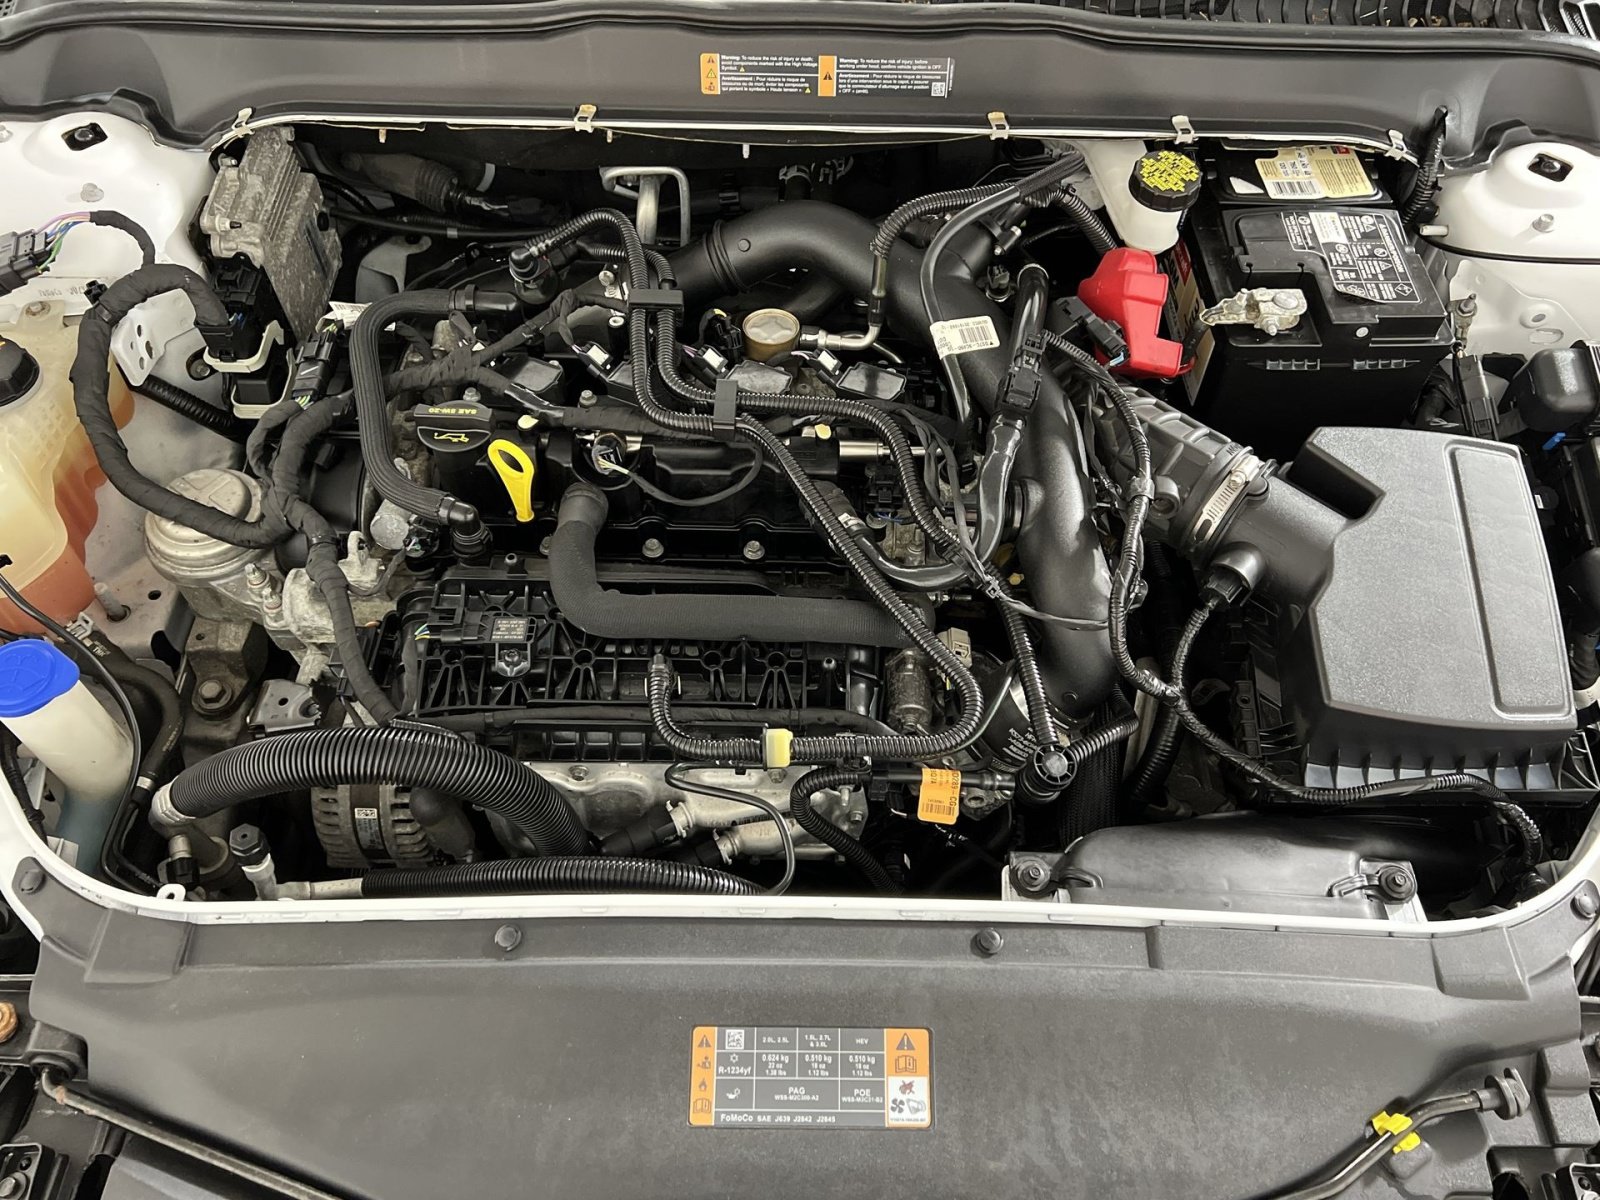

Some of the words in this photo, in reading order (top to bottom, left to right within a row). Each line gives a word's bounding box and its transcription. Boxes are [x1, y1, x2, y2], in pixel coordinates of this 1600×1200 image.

[780, 1054, 789, 1063] kg
[824, 1055, 832, 1063] kg
[867, 1055, 876, 1064] kg
[718, 1066, 752, 1076] R-1234yf
[720, 1114, 753, 1122] FoMoCo
